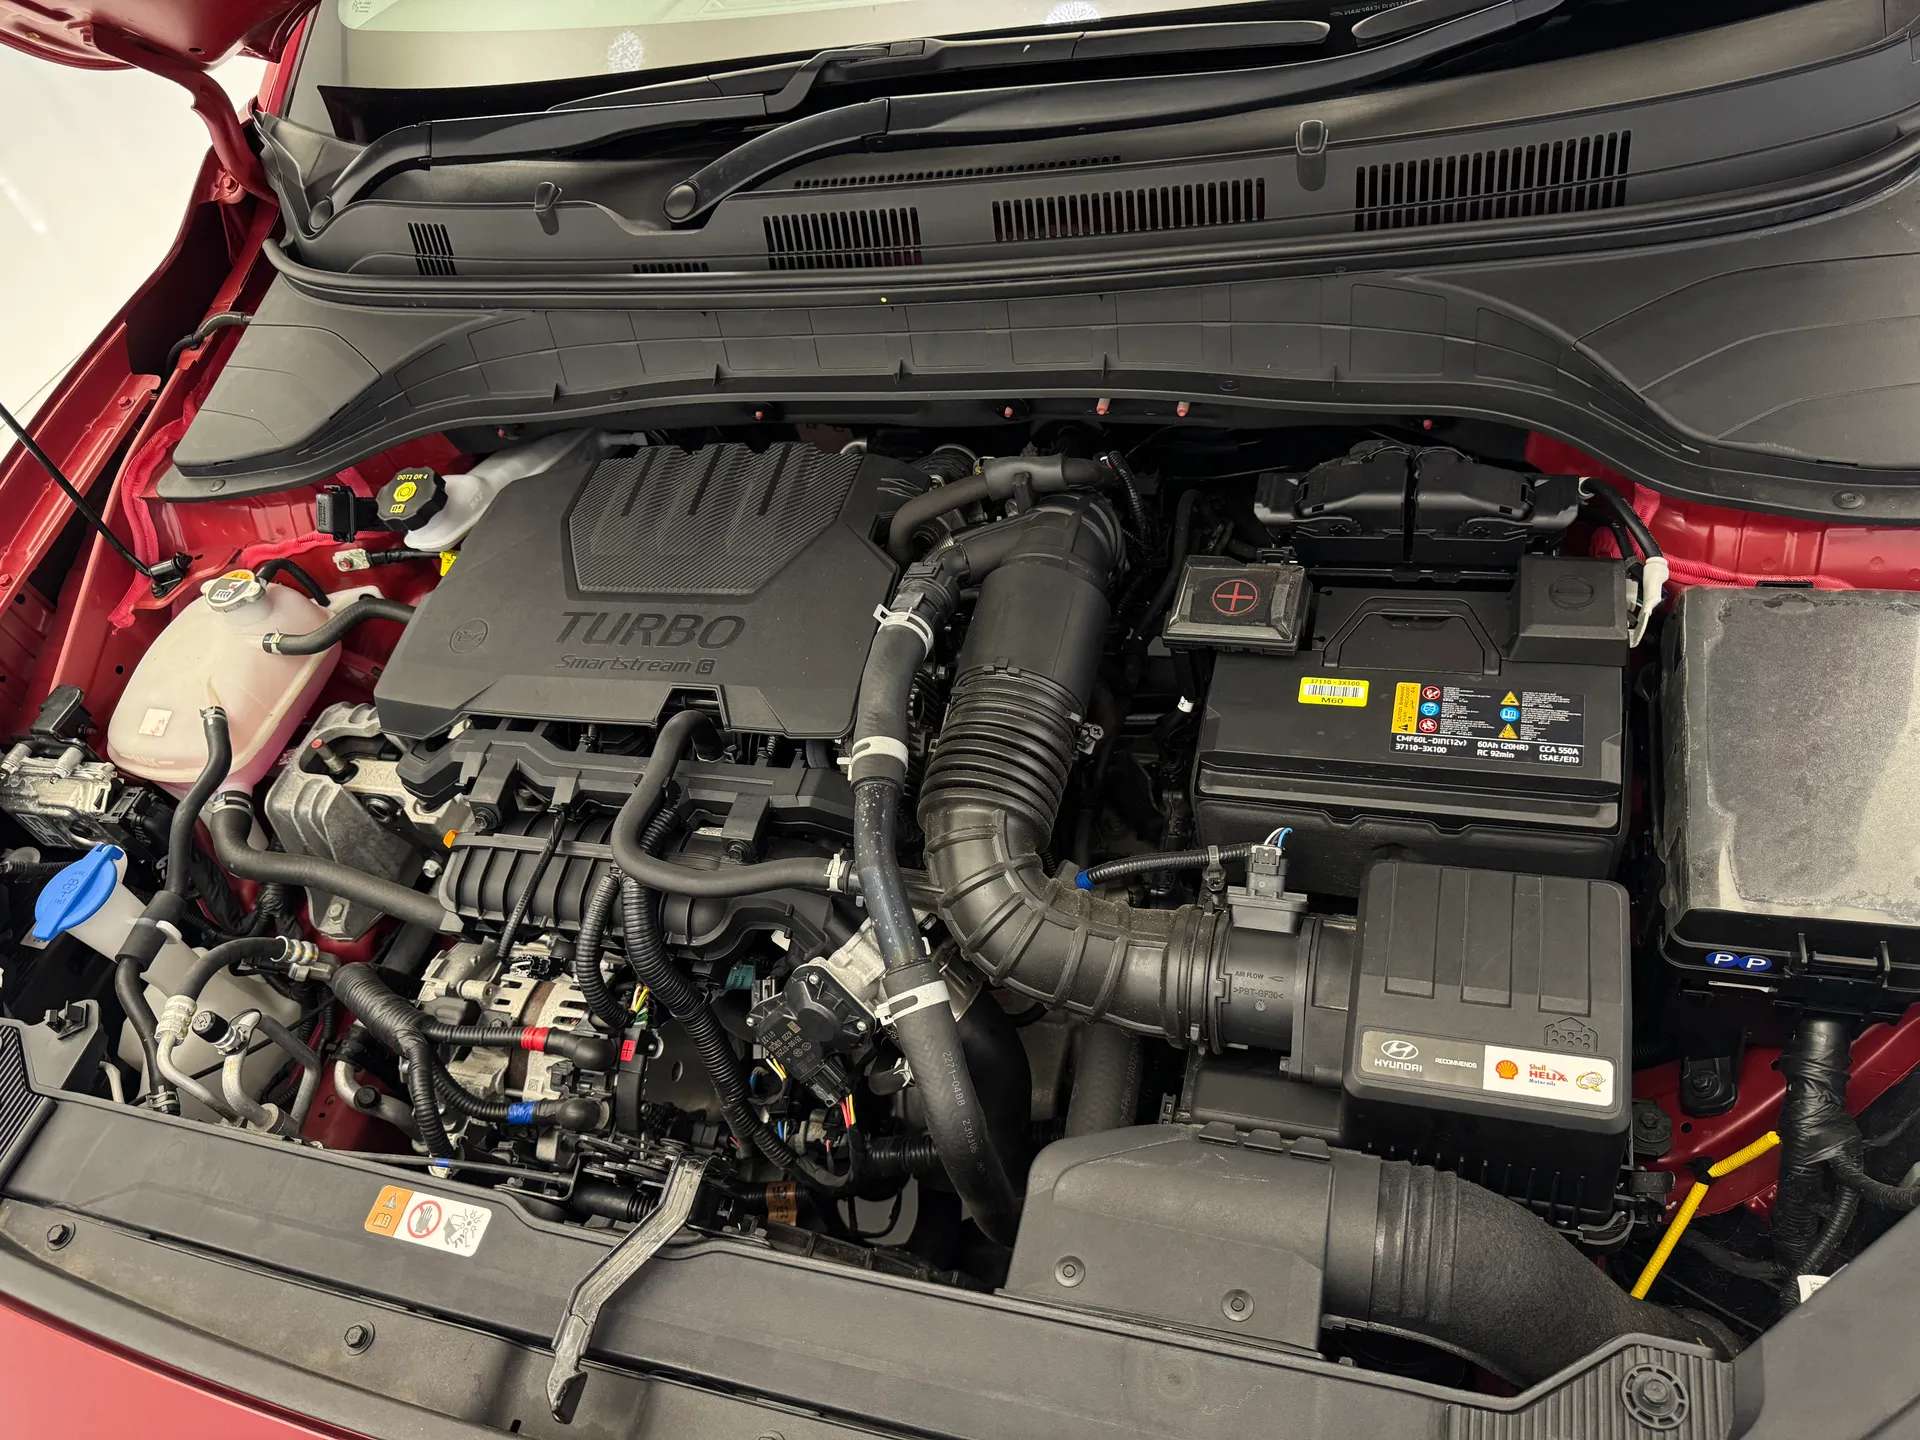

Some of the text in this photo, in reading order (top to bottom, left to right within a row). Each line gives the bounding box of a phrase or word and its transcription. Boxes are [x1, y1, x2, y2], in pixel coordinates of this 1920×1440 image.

[554, 611, 746, 649] TURBO
[554, 653, 693, 673] Smartstream
[1394, 743, 1448, 753] 37110-3X100
[1477, 740, 1529, 752] 60Ah (20HR)
[1539, 744, 1579, 756] CCA 550A
[1476, 749, 1515, 759] RC 92min
[1714, 954, 1766, 968] P P
[1246, 971, 1265, 979] FLOW
[1374, 1057, 1478, 1073] HYUNDAI RECOMMENDS
[1528, 1063, 1546, 1072] Shell
[1528, 1070, 1567, 1082] HELIX
